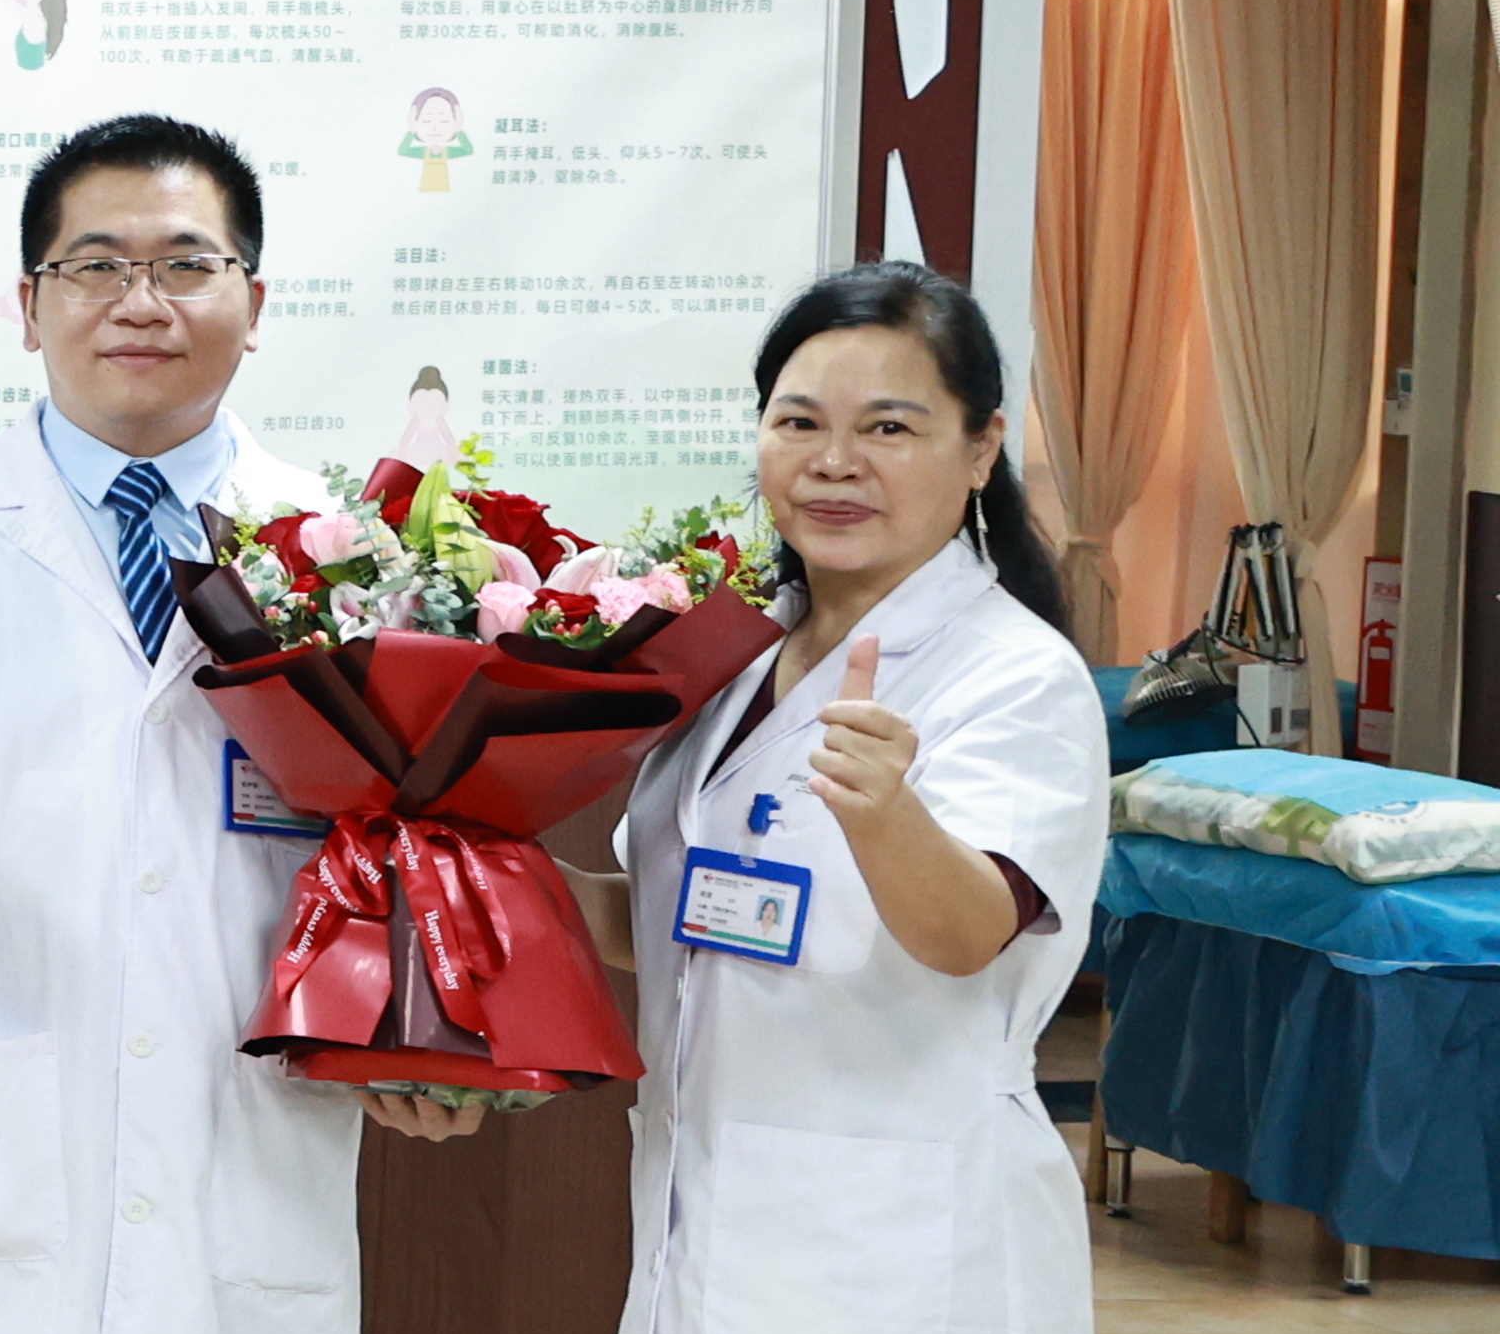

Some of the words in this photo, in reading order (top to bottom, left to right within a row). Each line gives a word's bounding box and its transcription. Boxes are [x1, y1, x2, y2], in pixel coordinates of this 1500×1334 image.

[268, 161, 308, 177] 和缓。
[264, 277, 355, 294] 足心顺时针
[258, 301, 356, 318] 固肾的作用。
[486, 451, 749, 469] 。可以使面部红润光泽，消除疲劳。
[286, 929, 314, 964] Happy
[424, 909, 442, 945] Happy
[434, 942, 460, 991] everyday
